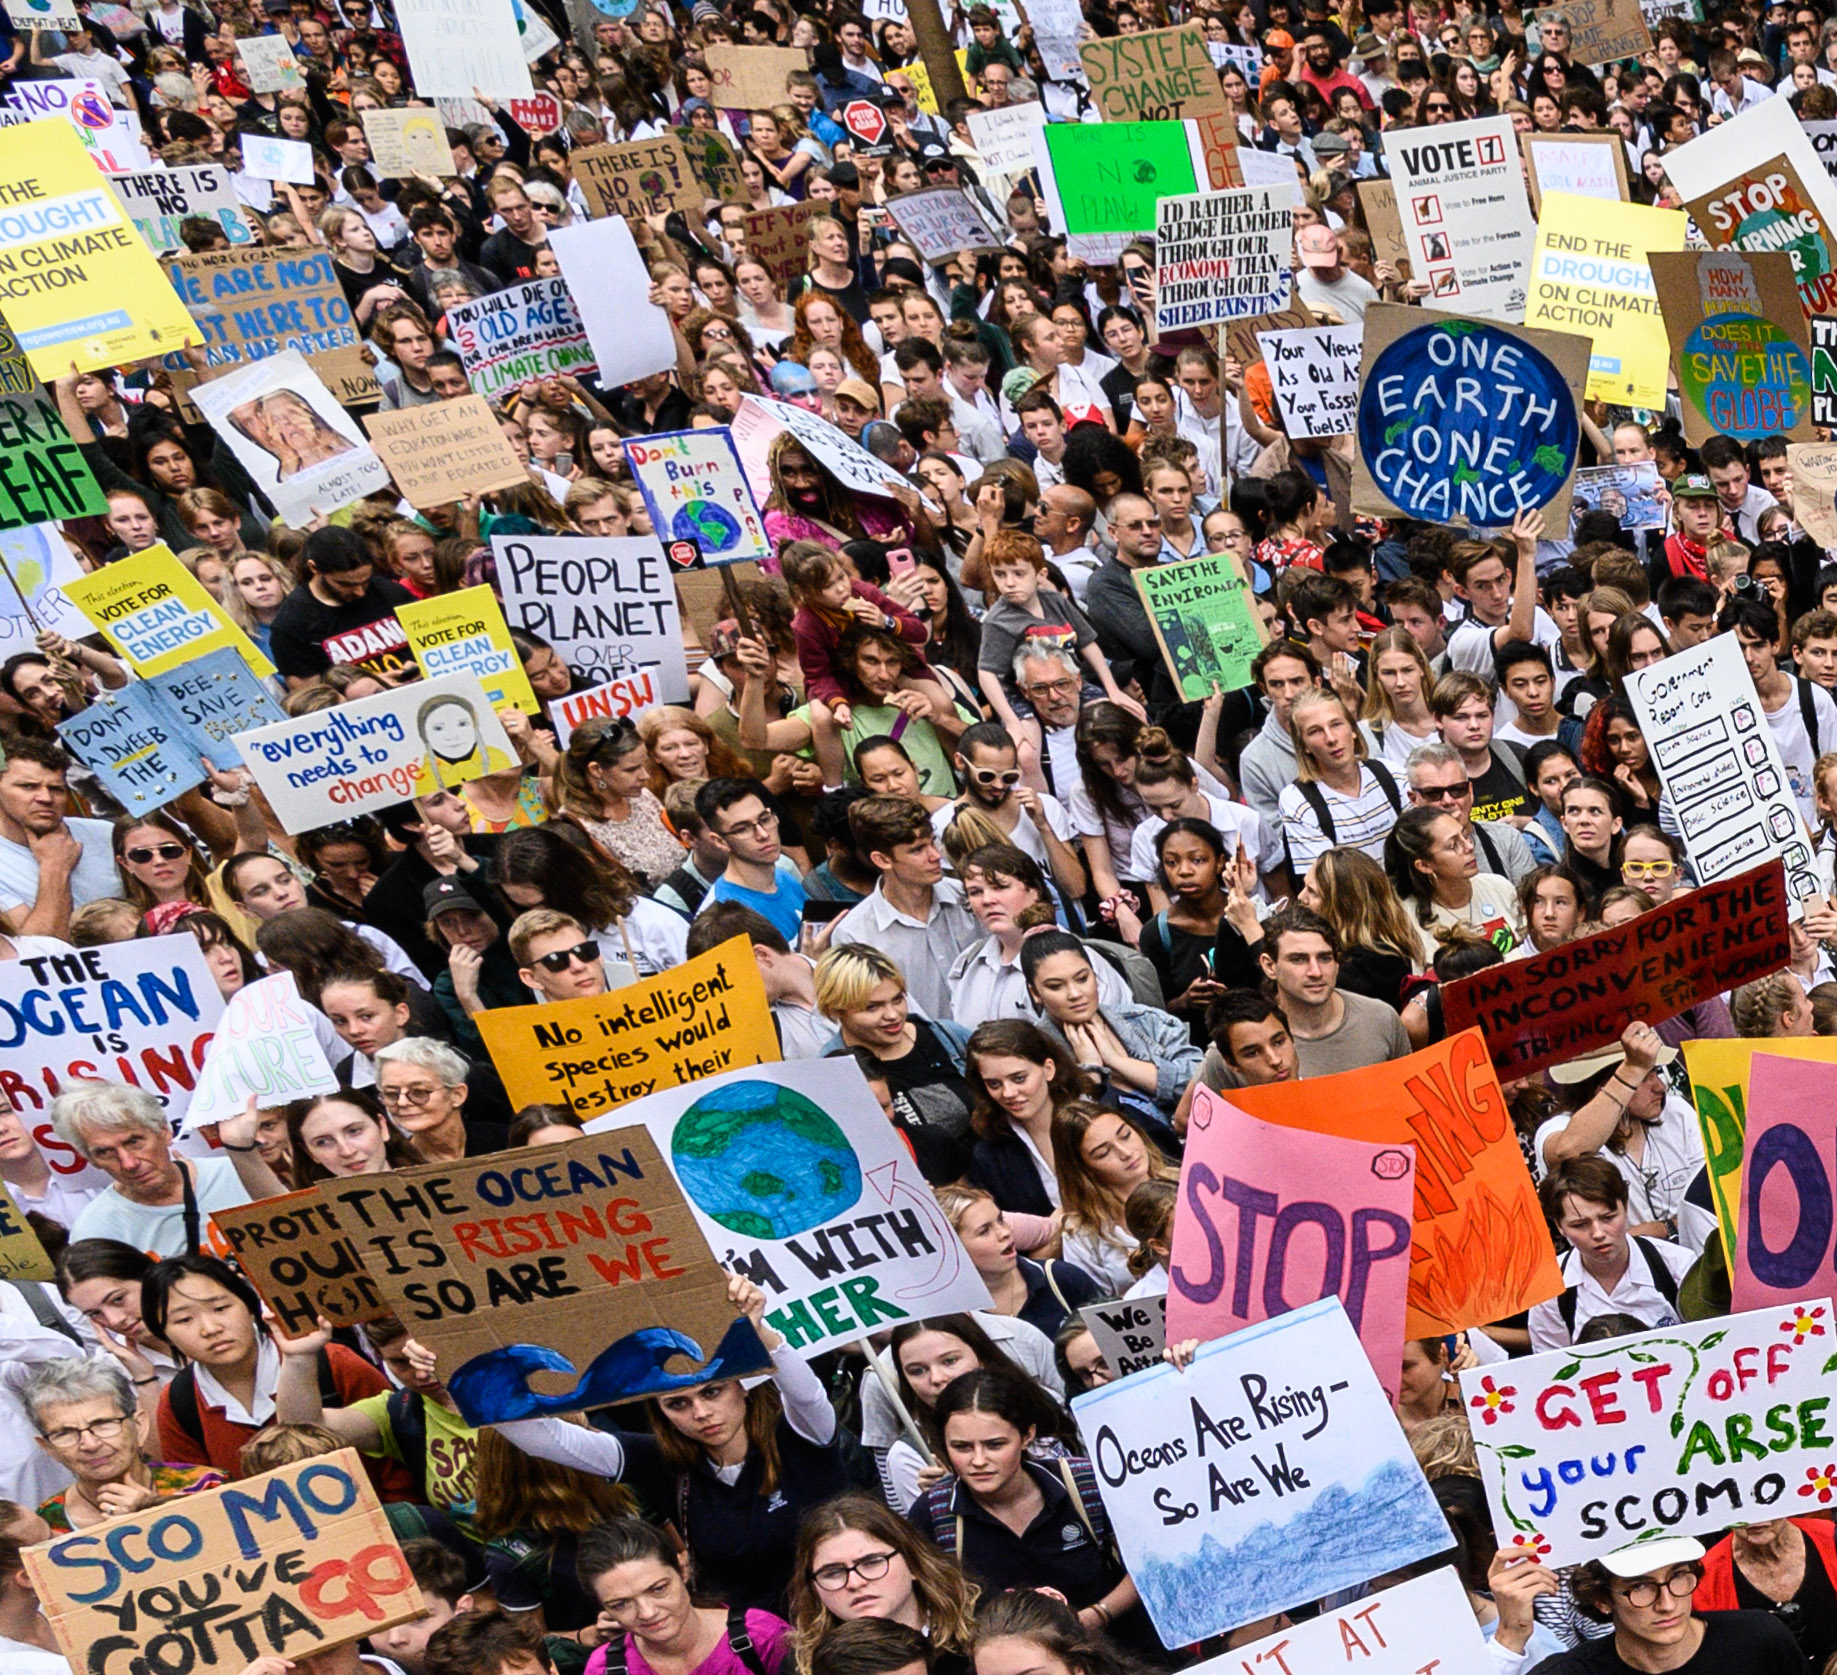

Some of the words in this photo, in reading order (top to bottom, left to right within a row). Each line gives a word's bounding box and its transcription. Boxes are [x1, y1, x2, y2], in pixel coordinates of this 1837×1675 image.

[1081, 30, 1213, 85] SYSTEM
[1103, 67, 1210, 117] CHANGE
[1140, 101, 1185, 121] NOT
[581, 152, 643, 176] THERE
[650, 145, 676, 167] IS
[1401, 140, 1475, 176] VOTE
[595, 177, 628, 200] NO
[1408, 176, 1442, 188] ANIMAL
[1444, 170, 1478, 182] JUSTICE
[1479, 166, 1507, 176] PARTY
[1163, 200, 1183, 223] I'D
[1190, 194, 1254, 218] RATHER
[1260, 192, 1271, 211] A
[1158, 219, 1216, 244] SLEDGE
[1221, 209, 1292, 235] HAMMER
[1159, 240, 1234, 265] THROUGH
[1238, 236, 1269, 255] OUR
[1159, 260, 1232, 285] ECONOMY
[1235, 254, 1279, 276] THAN
[1159, 278, 1242, 305] THROUGH
[1246, 275, 1270, 293] OUR
[1159, 302, 1212, 328] SHEER
[1428, 332, 1524, 381] ONE
[1378, 374, 1558, 432] EARTH
[380, 421, 416, 437] WHY
[421, 409, 451, 428] GET
[459, 405, 479, 417] AN
[1413, 424, 1515, 475] ONE
[317, 474, 352, 494] ALMOST
[358, 461, 379, 477] TOO
[332, 484, 364, 502] LATE!
[1375, 448, 1541, 521] CHANCE
[504, 543, 660, 596] PEOPLE
[521, 601, 673, 641] PLANET
[575, 645, 637, 666] OVER
[286, 753, 359, 791] needs
[366, 743, 391, 776] to
[1533, 1362, 1674, 1432] GET
[1702, 1341, 1793, 1403] OFF
[1520, 1442, 1649, 1520] your
[1673, 1395, 1835, 1477] ARSE
[1579, 1471, 1787, 1541] SCOMO
